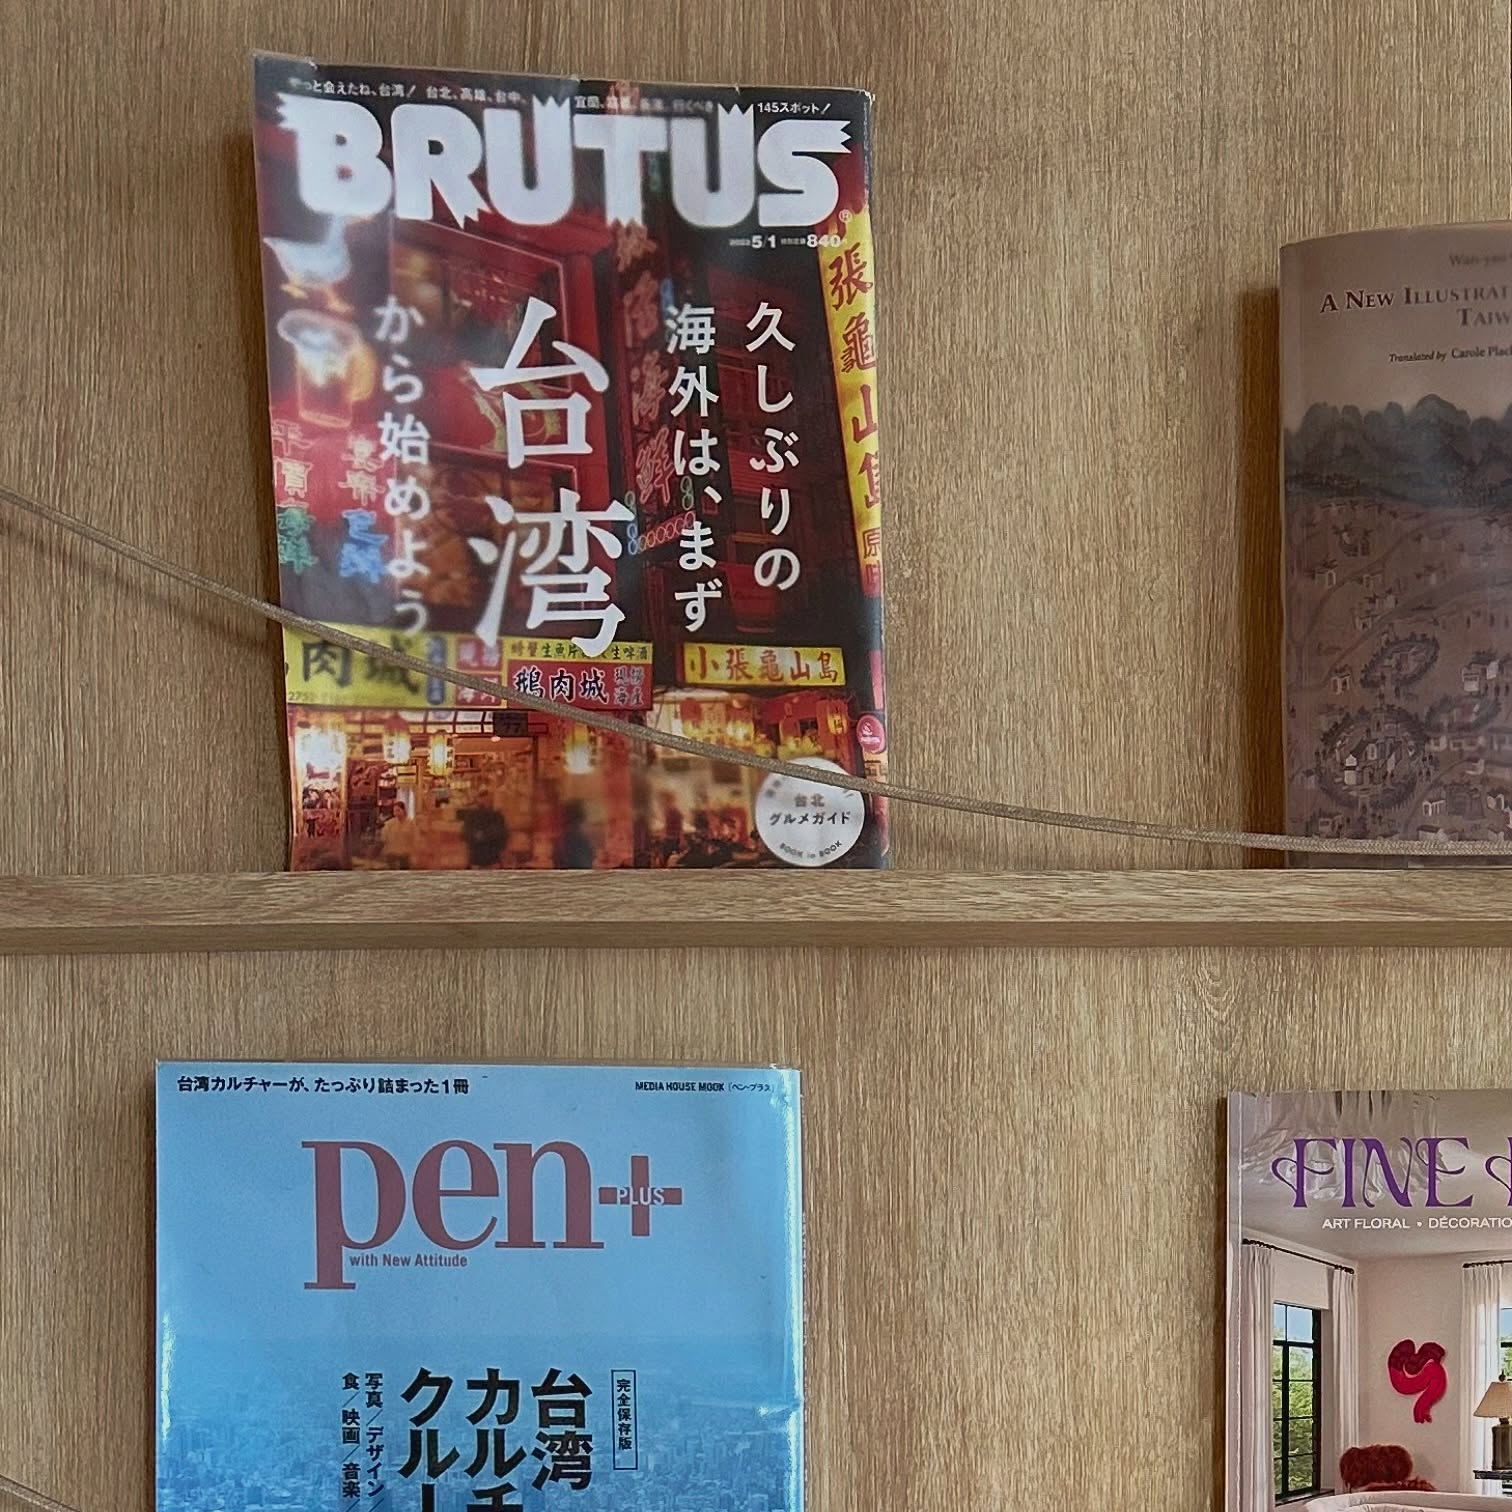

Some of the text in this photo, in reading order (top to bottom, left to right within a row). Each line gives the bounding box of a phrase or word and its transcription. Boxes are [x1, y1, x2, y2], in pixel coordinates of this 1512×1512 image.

[277, 92, 853, 229] BRUTUS
[1320, 293, 1339, 313] A
[1389, 352, 1432, 364] Translated
[1435, 351, 1446, 365] by
[1451, 347, 1487, 360] Carole
[745, 301, 801, 590] 久しぶりの
[374, 297, 431, 638] から始めよう
[466, 296, 638, 658] 台湾
[666, 303, 723, 633] 海外は、まず
[514, 665, 609, 704] 鵝肉城
[770, 811, 851, 826] グルメガイド
[177, 1076, 470, 1095] 台湾カルチャーが、たっぷり詰まった1冊
[635, 1081, 664, 1091] MEDIA
[666, 1082, 696, 1091] HOUSE
[698, 1082, 725, 1092] MOOK
[1271, 1136, 1473, 1208] FINE
[616, 1187, 665, 1206] PLUS
[1322, 1217, 1352, 1230] ART
[1354, 1217, 1409, 1229] FLORAL
[350, 1253, 468, 1268] with New Attitude
[531, 1367, 593, 1491] 台湾
[616, 1378, 632, 1450] 完全保存版
